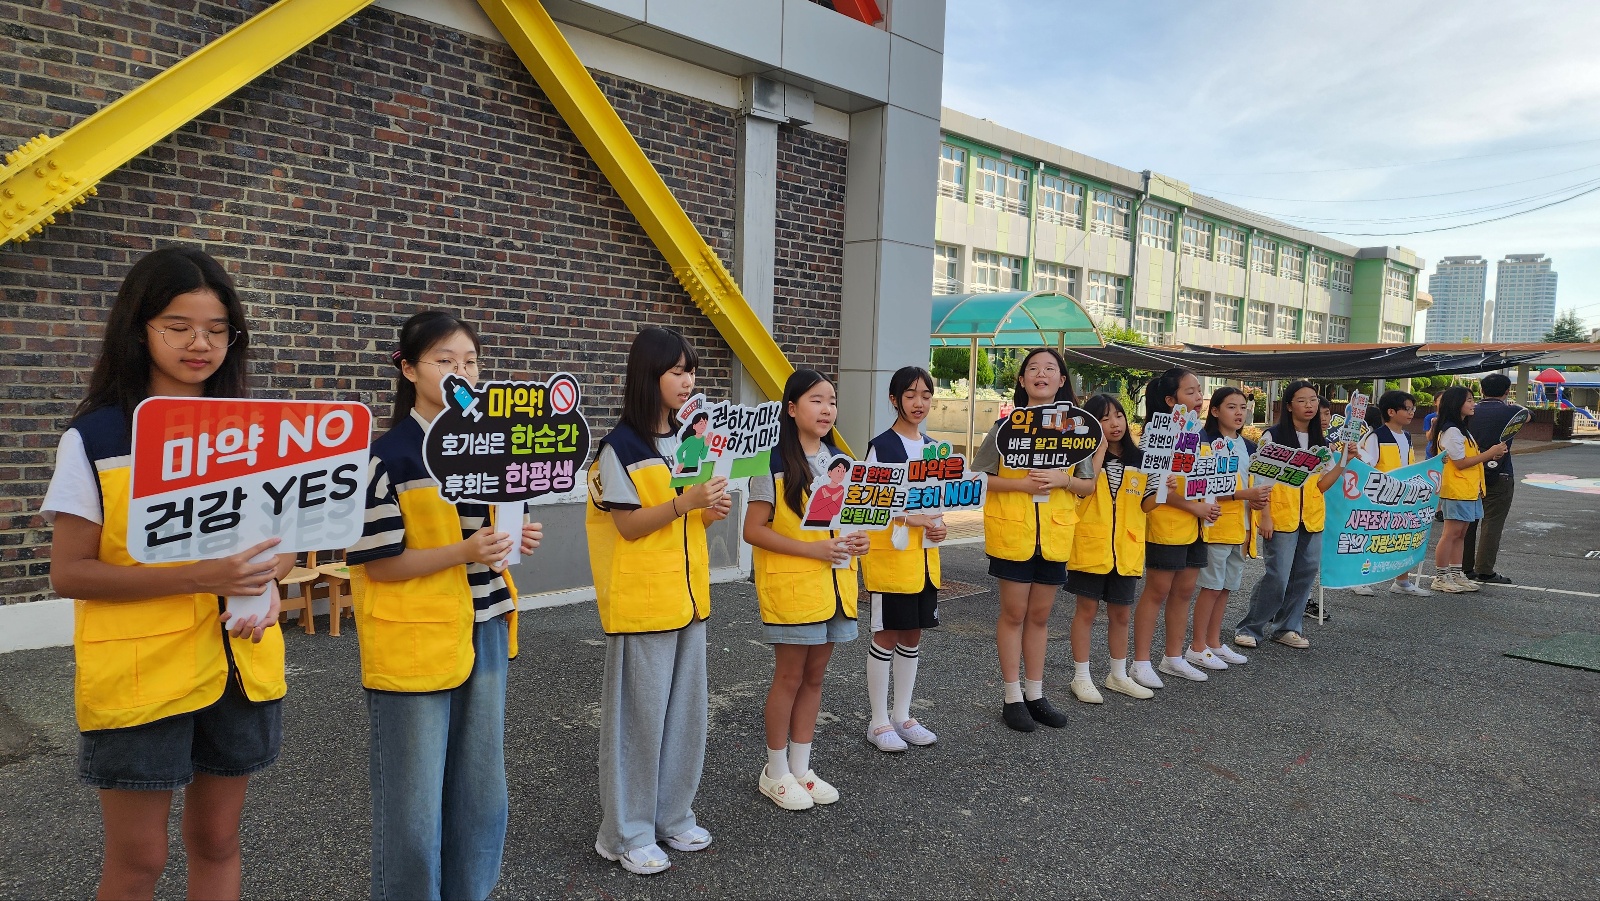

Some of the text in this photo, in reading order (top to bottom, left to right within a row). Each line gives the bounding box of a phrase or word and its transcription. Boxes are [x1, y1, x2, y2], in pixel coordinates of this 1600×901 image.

[488, 387, 544, 418] 마약!
[712, 404, 779, 432] 권하지마!
[1011, 411, 1037, 435] 약,
[1152, 414, 1172, 432] 마약,
[161, 409, 353, 481] 마약 NO
[441, 423, 579, 455] 호기심은 한순간
[710, 425, 778, 457] 약하지마!
[922, 442, 950, 460] NO
[1008, 437, 1096, 450] 바로 알고 먹어야
[1148, 433, 1175, 449] 한번의
[1175, 432, 1199, 453] 시작
[908, 457, 964, 481] 마약은
[1006, 453, 1070, 467] 약이 됩니다.
[1143, 452, 1195, 473] 한방에 끝장
[1217, 456, 1228, 474] 내
[1260, 444, 1322, 472] 순간의 쾌락
[444, 472, 499, 496] 후회는
[505, 459, 573, 494] 한평생
[851, 465, 904, 485] 단 한번의
[1248, 460, 1309, 487] 영원한 고통
[845, 484, 906, 508] 호기심도
[944, 479, 983, 507] NO!
[1186, 479, 1207, 497] 마약
[145, 463, 359, 547] 건강 YES
[840, 507, 891, 526] 안됩니다
[1345, 509, 1391, 531] 시작조차
